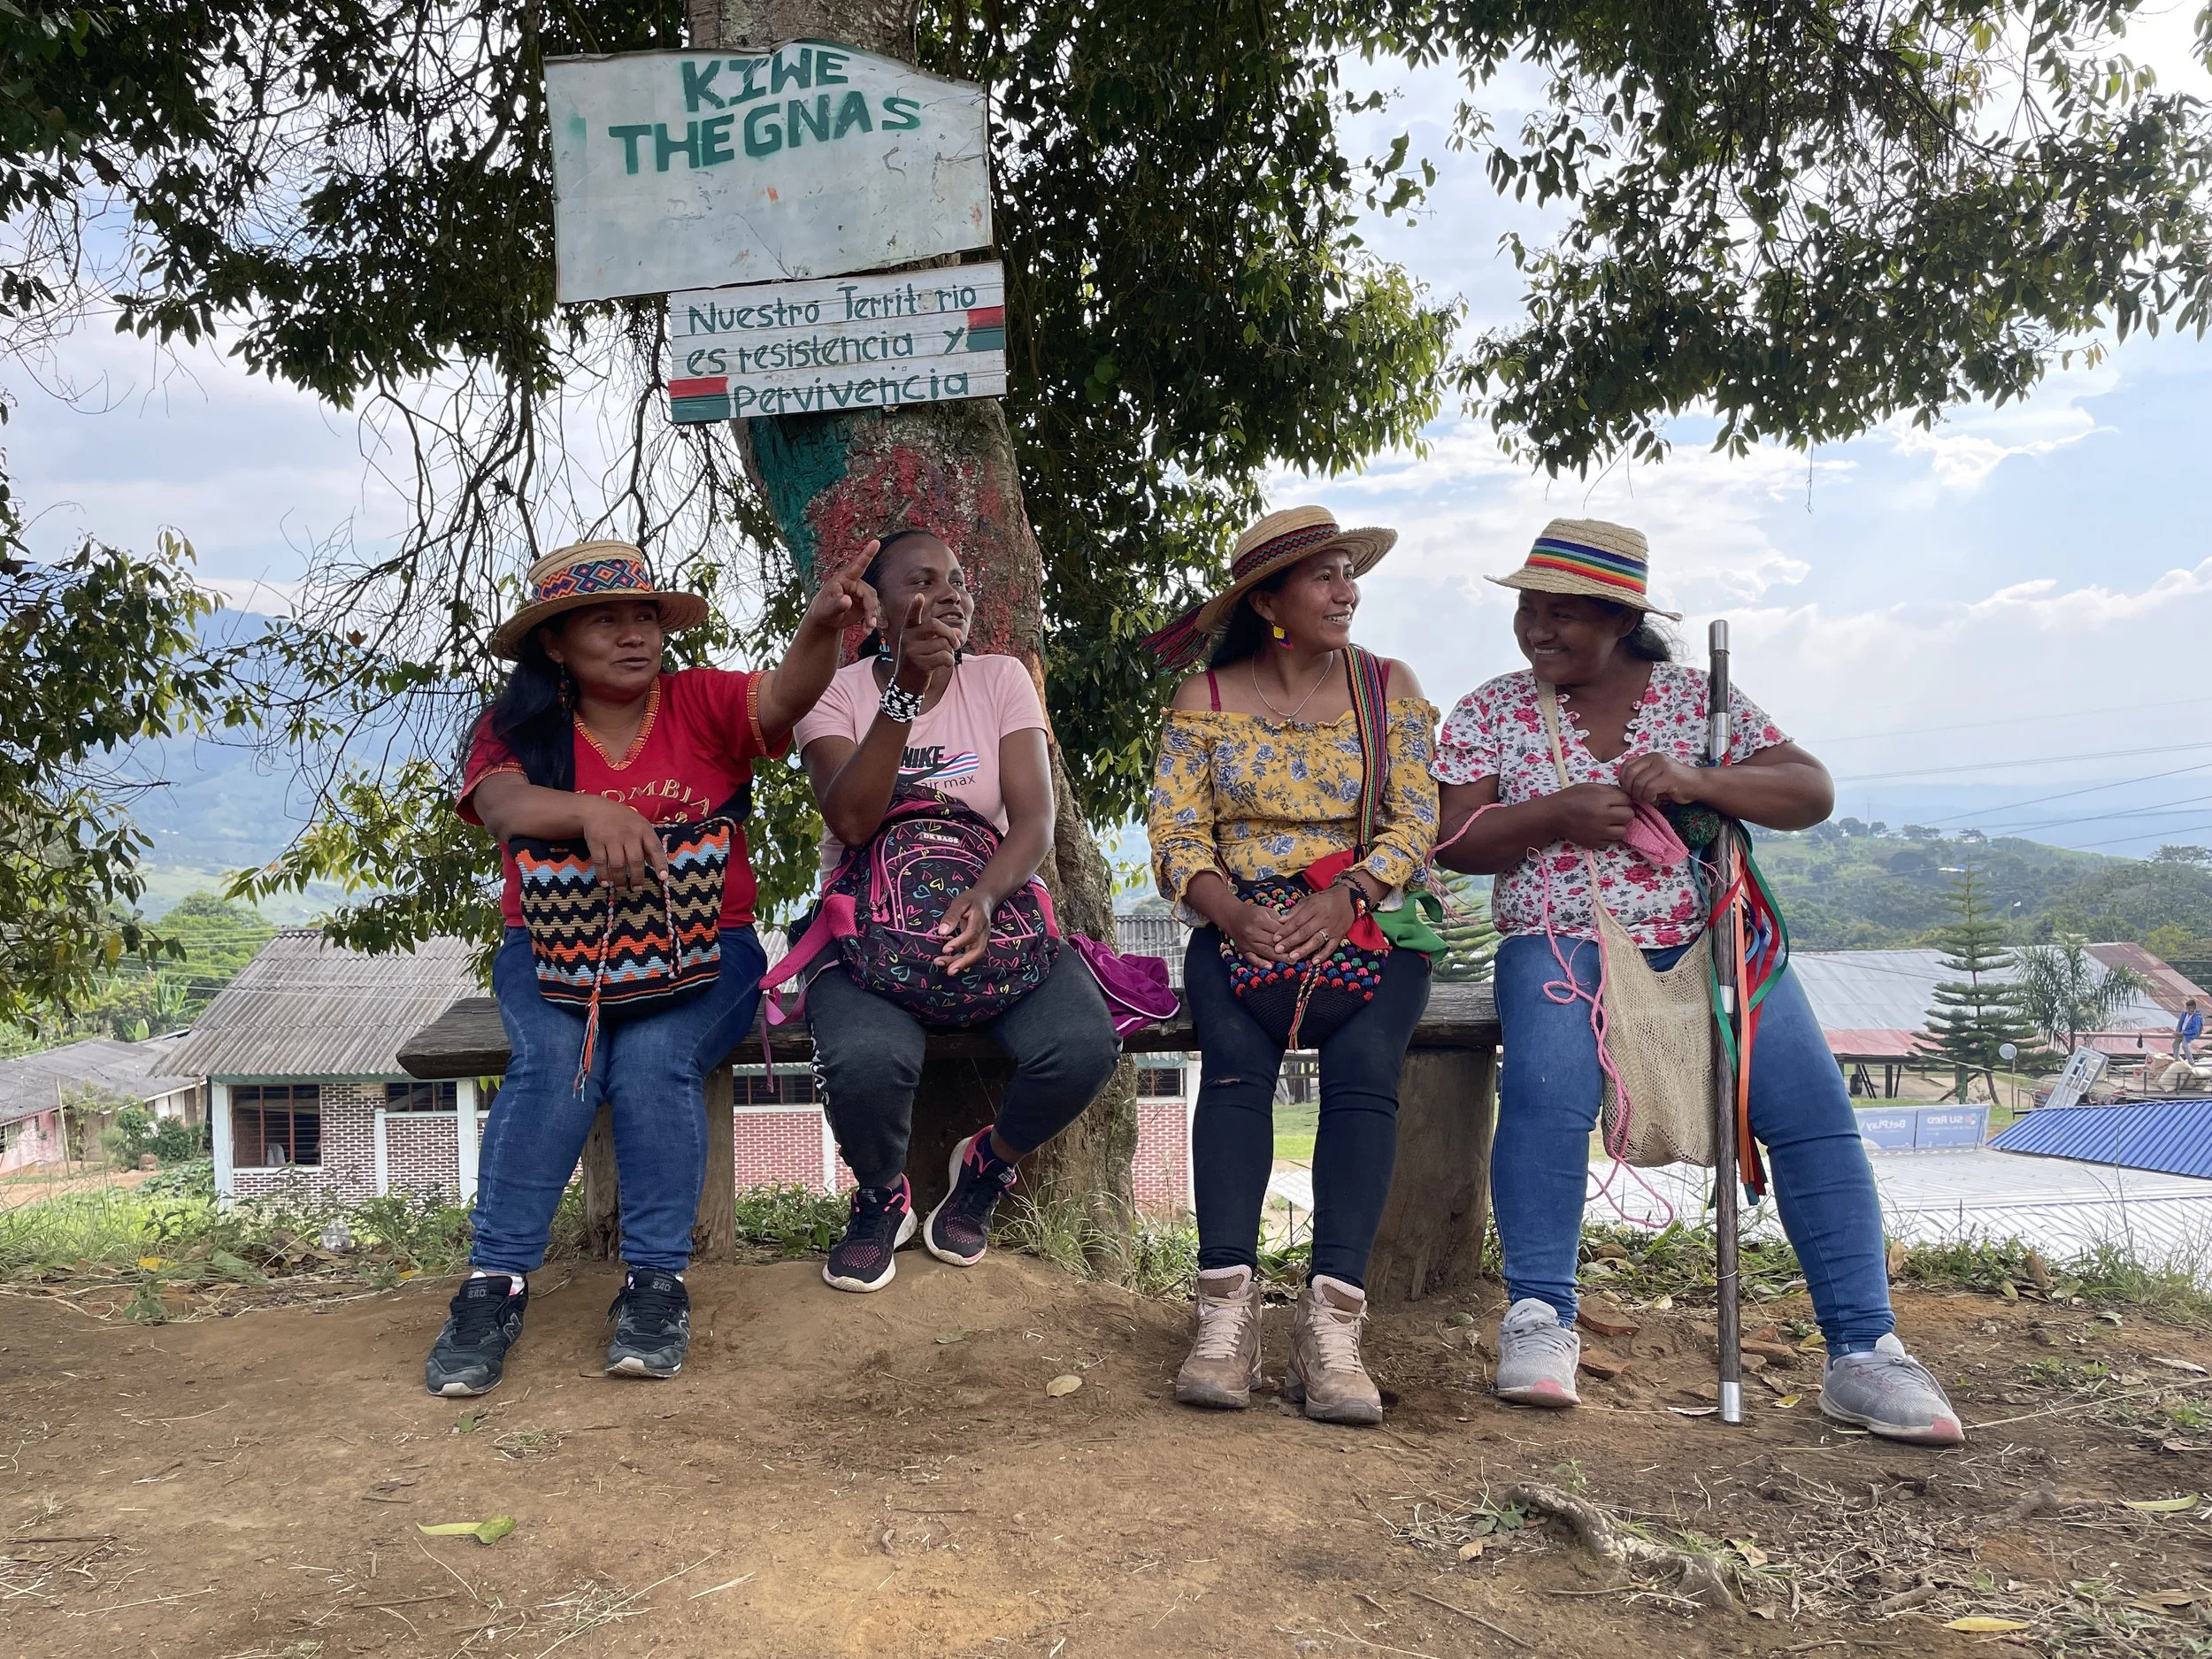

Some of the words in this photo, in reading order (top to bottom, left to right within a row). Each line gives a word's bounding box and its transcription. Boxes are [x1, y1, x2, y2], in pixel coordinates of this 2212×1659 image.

[680, 48, 850, 112] KIWE
[608, 90, 921, 175] THEGNAS
[687, 296, 820, 335] Nuestro
[835, 282, 977, 320] Territrio
[686, 348, 727, 377] es
[738, 330, 913, 373] resistencia
[901, 745, 946, 769] NIKE
[943, 774, 976, 789] max
